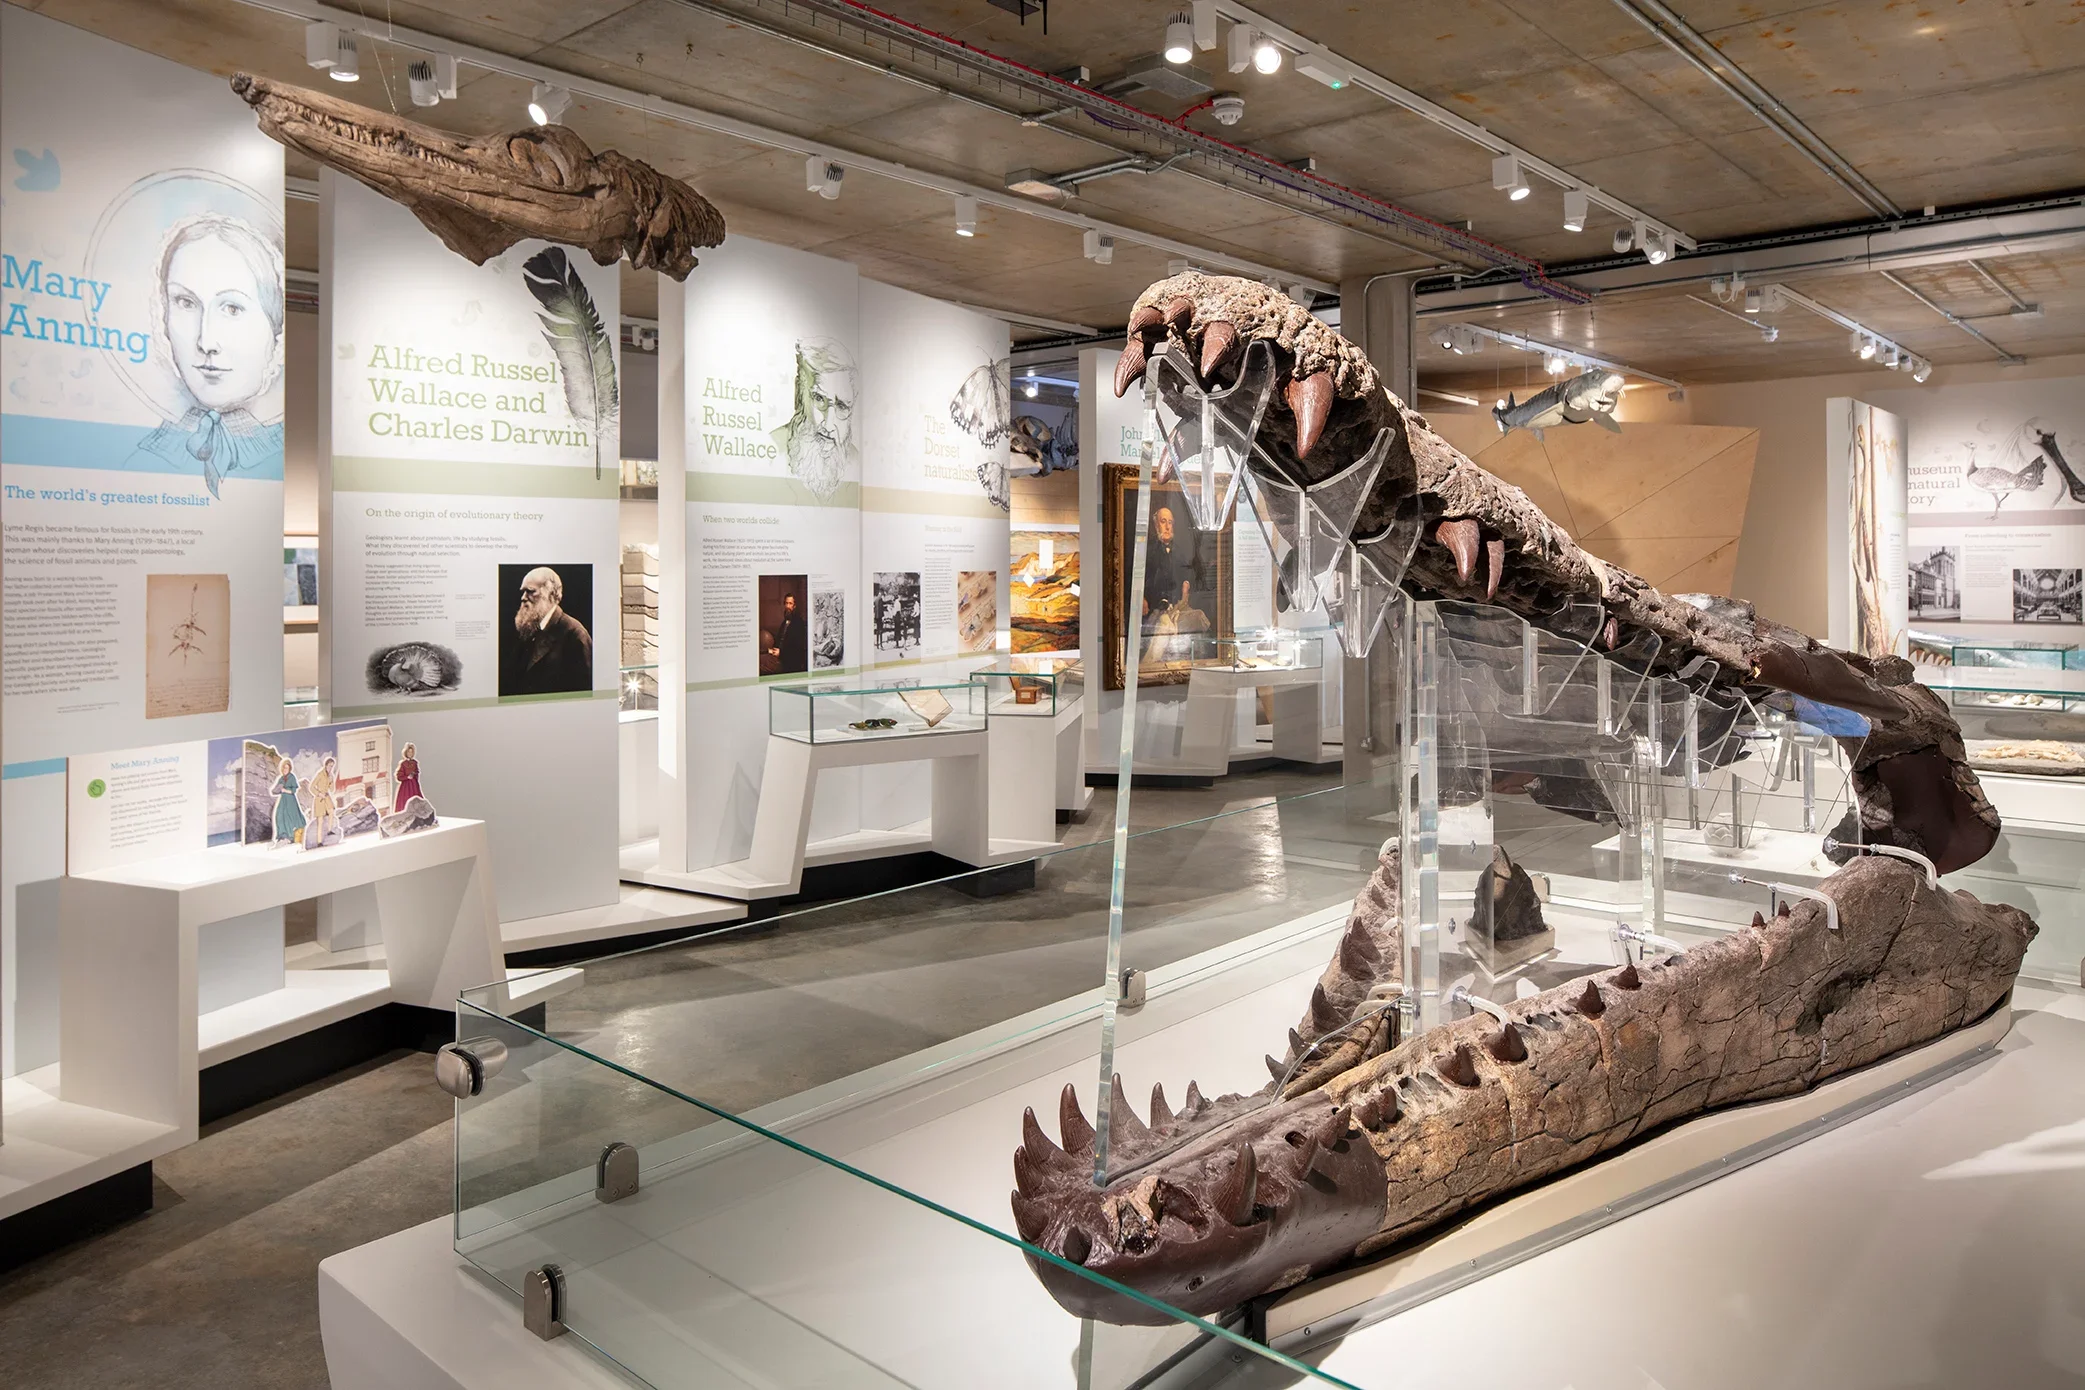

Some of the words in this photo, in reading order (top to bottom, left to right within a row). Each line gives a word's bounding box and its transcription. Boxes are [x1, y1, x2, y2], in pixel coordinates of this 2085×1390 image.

[2, 254, 111, 313] Mary
[1, 303, 150, 363] Anning
[368, 344, 465, 375] Alfred
[471, 354, 559, 383] Russel
[368, 378, 487, 409] Wallace
[496, 392, 547, 413] and
[702, 377, 763, 403] Alfred
[368, 412, 484, 440] Charles
[491, 420, 590, 447] Darwin
[702, 405, 763, 431] Russel
[924, 414, 946, 434] The
[702, 433, 777, 459] Wallace
[924, 436, 960, 459] Dorset
[924, 464, 978, 482] naturalists
[4, 485, 35, 499] The
[40, 488, 96, 501] world's
[101, 493, 158, 505] greatest
[162, 493, 210, 506] fossilist
[366, 508, 382, 517] On
[385, 508, 402, 517] the
[404, 510, 435, 520] origin
[438, 509, 448, 518] of
[450, 510, 511, 521] evolutionary
[513, 511, 544, 522] theory
[703, 515, 723, 523] When
[736, 516, 758, 524] worlds
[759, 516, 780, 524] collide
[5, 534, 20, 543] This
